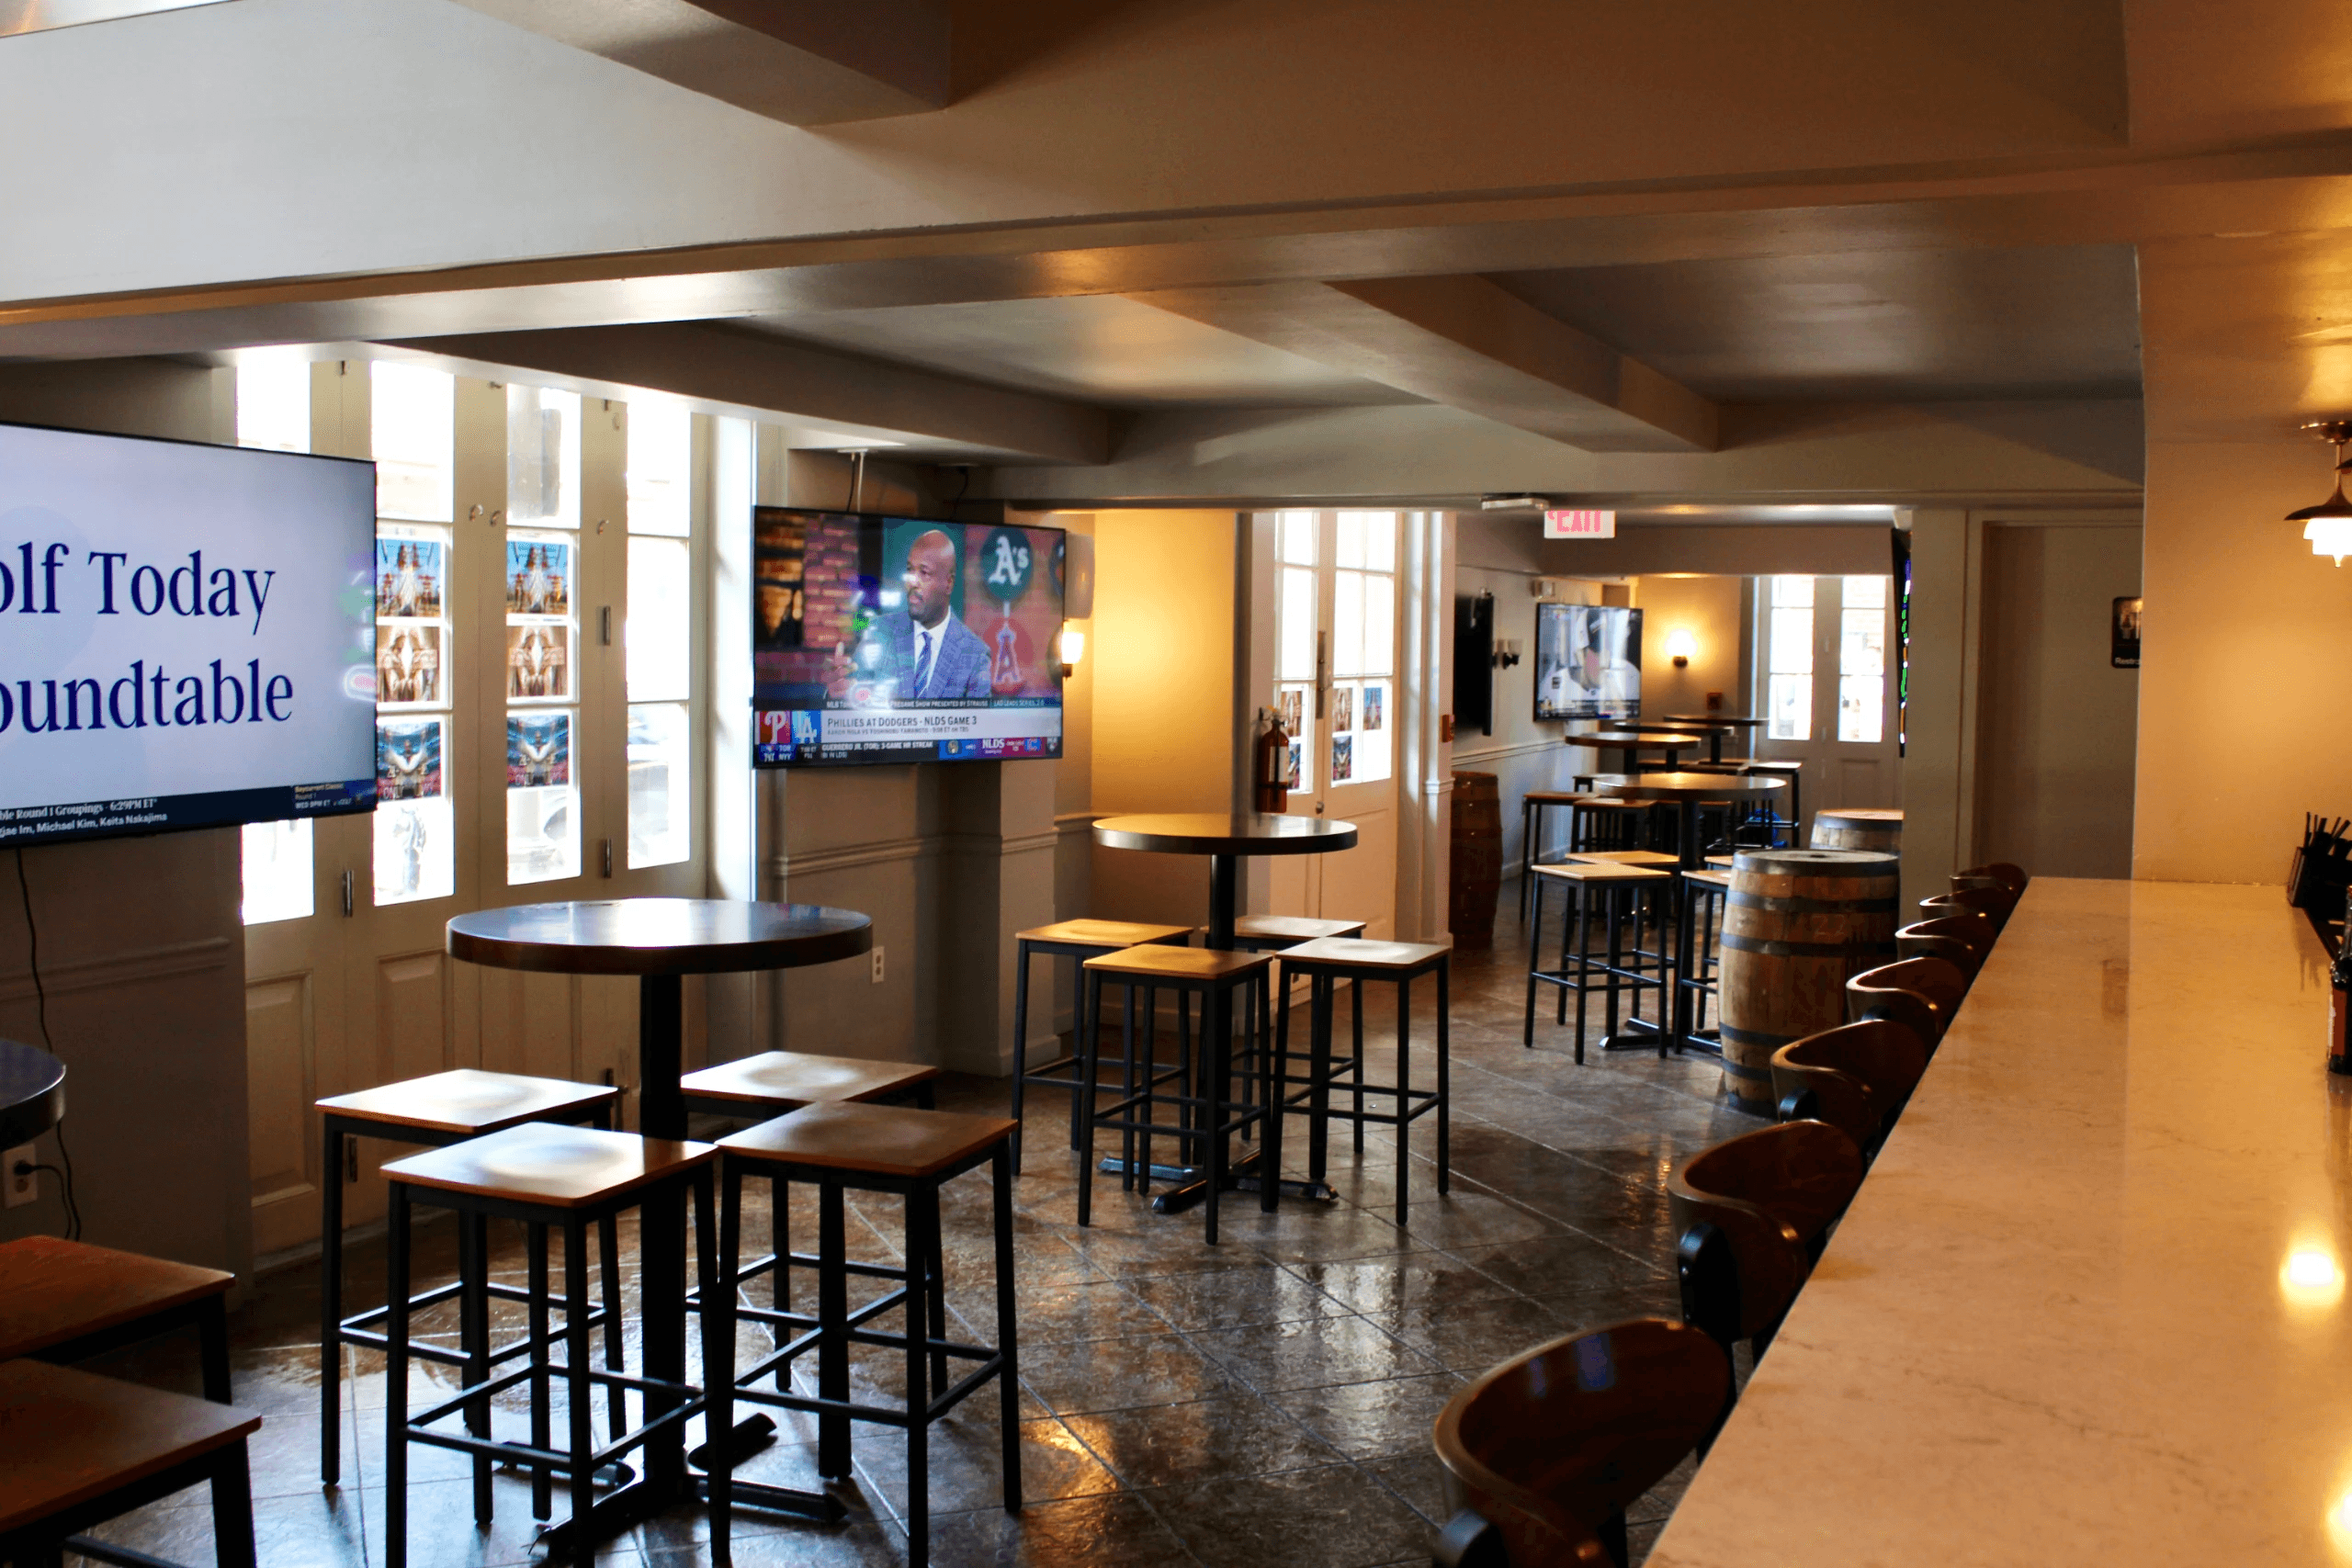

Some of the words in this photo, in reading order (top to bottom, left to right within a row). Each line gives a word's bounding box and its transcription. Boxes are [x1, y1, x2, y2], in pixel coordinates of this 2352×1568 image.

[88, 549, 277, 636] Today
[764, 711, 786, 744] P
[828, 717, 865, 728] PHILLIES
[866, 717, 876, 727] AT
[878, 716, 918, 727] DODGERS
[924, 716, 946, 726] NLDS
[947, 716, 970, 725] GAME
[972, 716, 978, 725] 3
[912, 740, 933, 749] STREAK
[982, 739, 1005, 749] NLDS
[16, 807, 48, 819] Round
[55, 803, 104, 817] Groupings
[37, 820, 75, 833] Michael
[76, 819, 98, 829] Kim,
[99, 816, 124, 827] Keita
[126, 812, 167, 825] Nakajima
